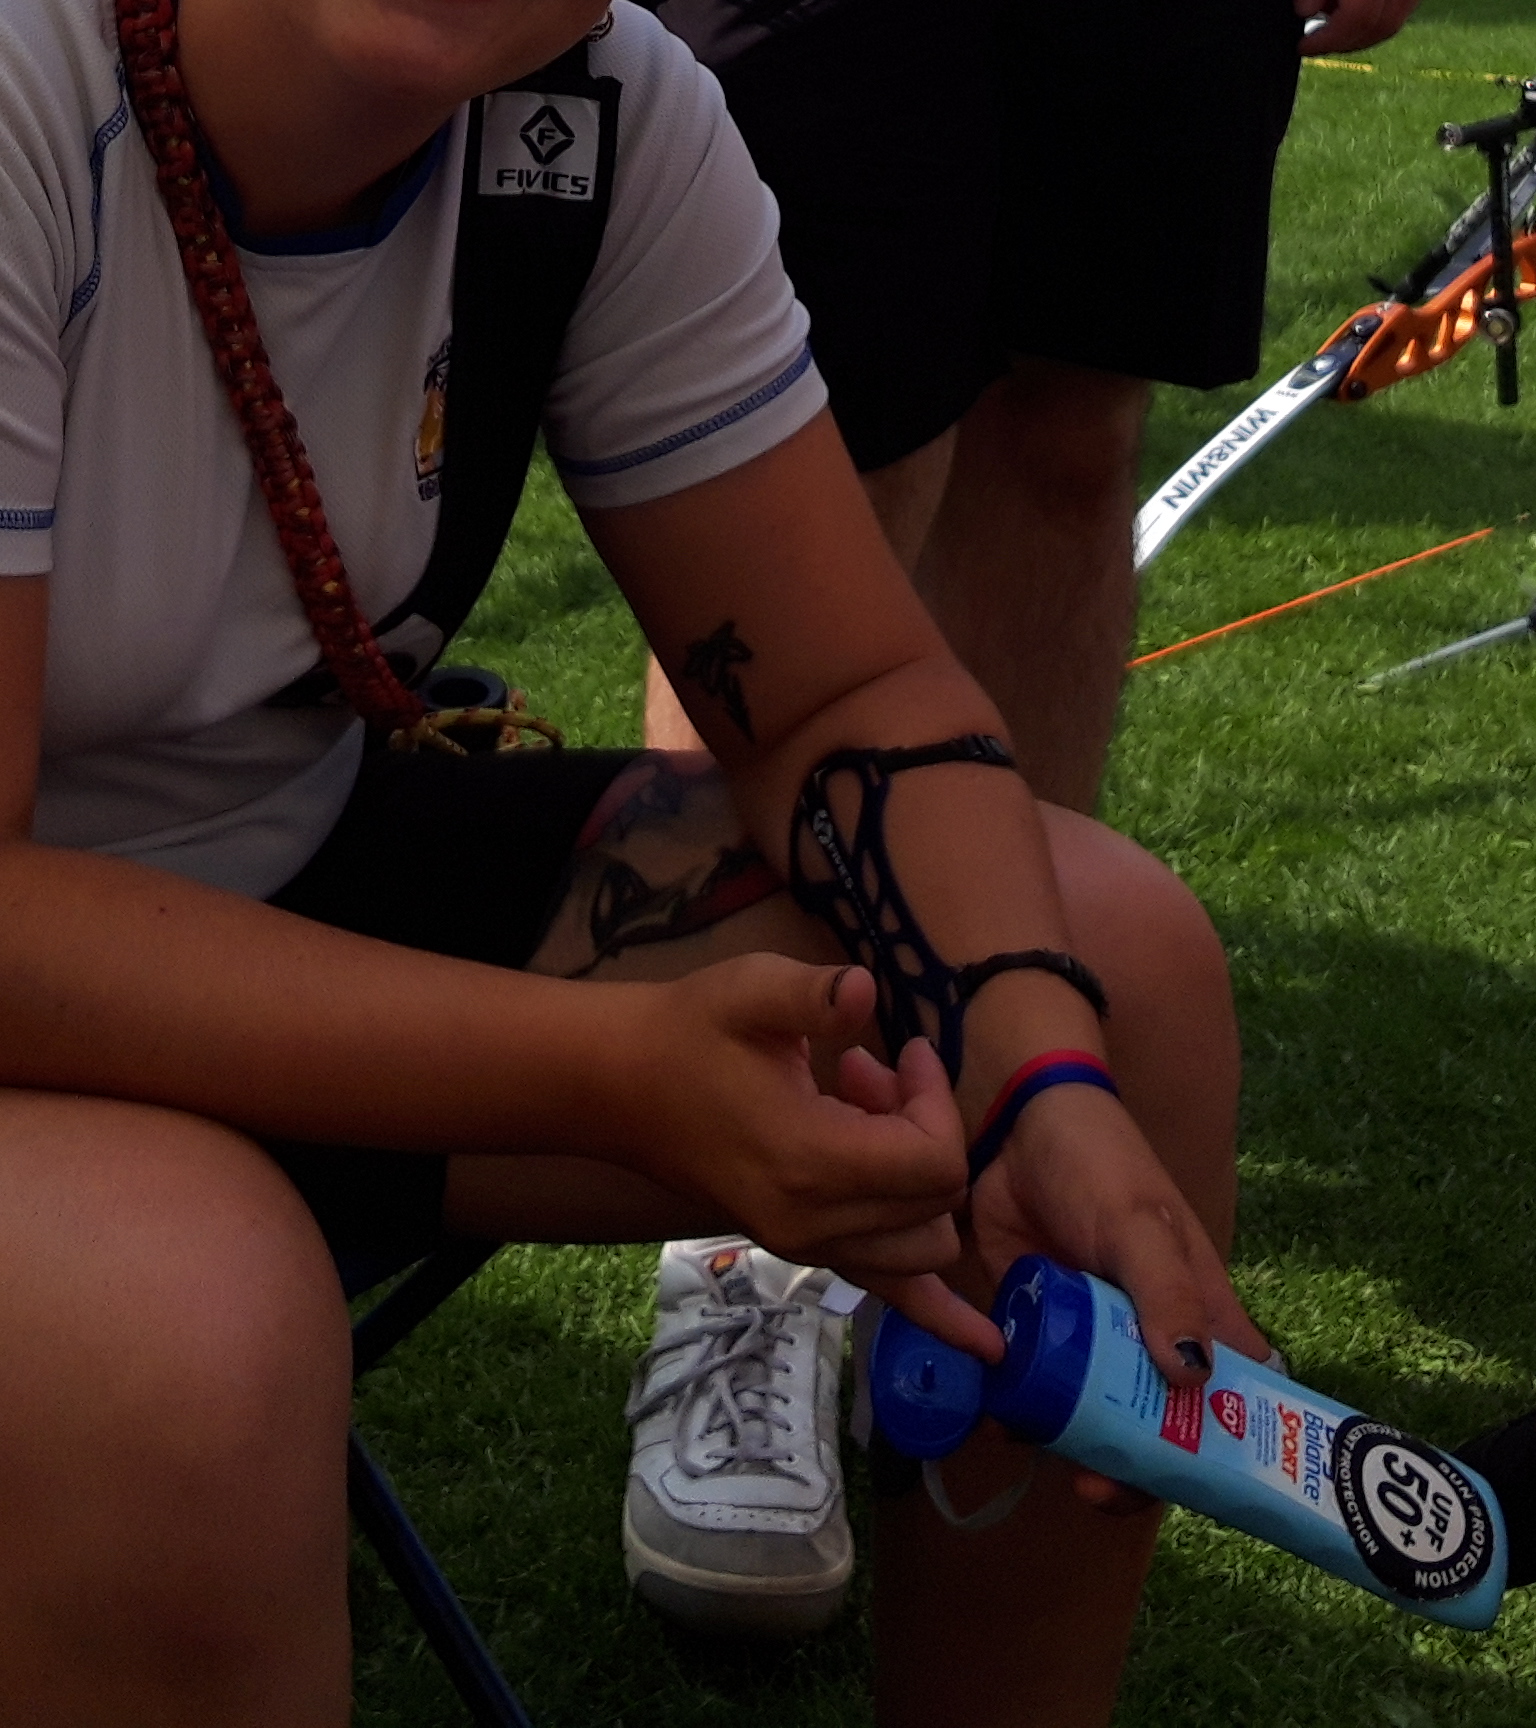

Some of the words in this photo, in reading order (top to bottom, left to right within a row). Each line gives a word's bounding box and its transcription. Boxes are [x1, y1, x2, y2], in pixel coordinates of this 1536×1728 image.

[496, 169, 590, 196] FIVICS
[1162, 406, 1279, 510] WIN&WIN
[1276, 1402, 1302, 1484] SPORT
[1303, 1409, 1325, 1505] Balance
[1438, 1461, 1474, 1500] SUN
[1336, 1448, 1380, 1556] PROTECTION
[1424, 1492, 1453, 1554] UPF
[1414, 1504, 1487, 1588] PROTECTION
